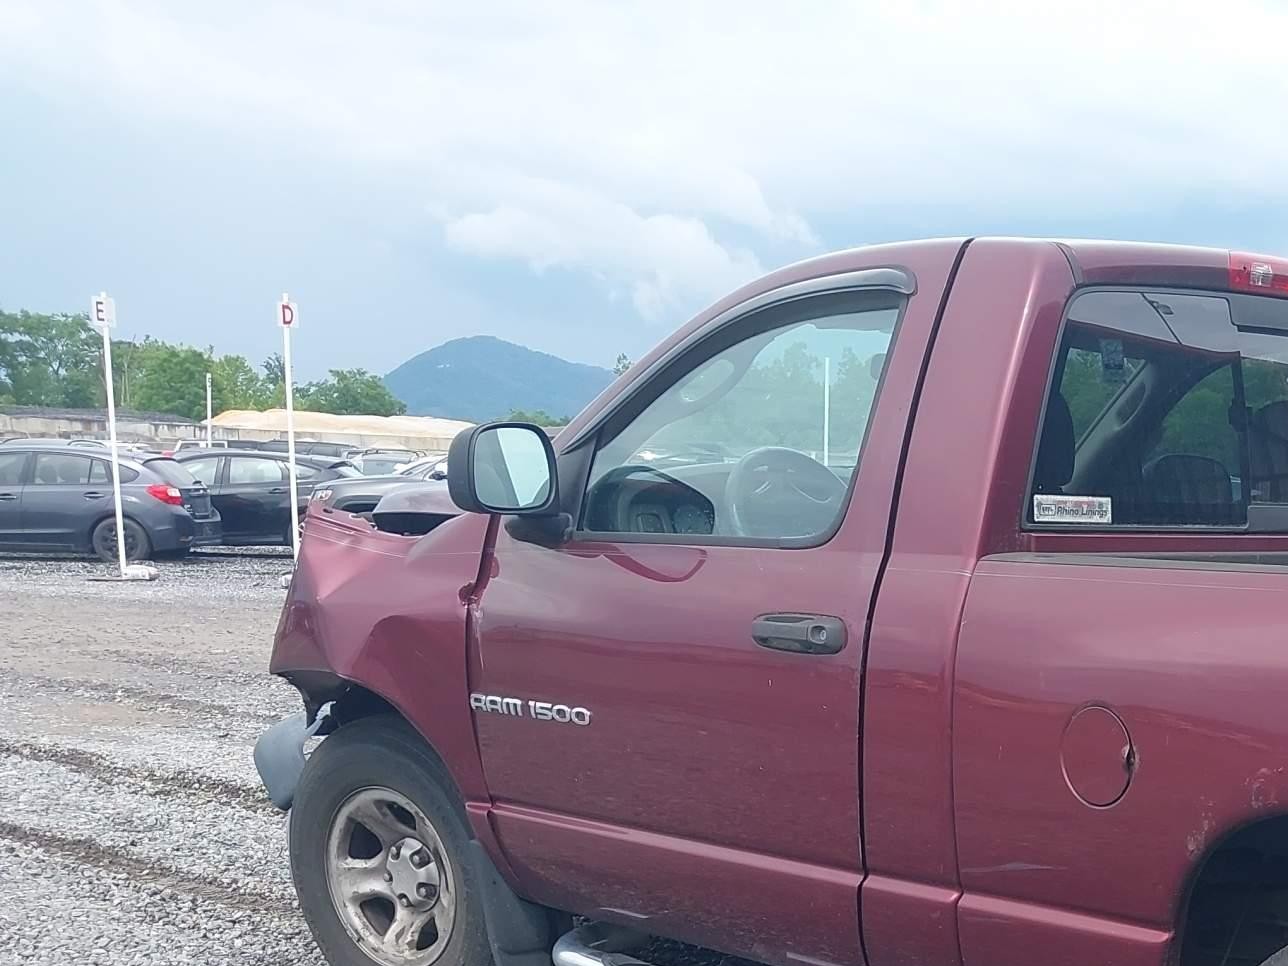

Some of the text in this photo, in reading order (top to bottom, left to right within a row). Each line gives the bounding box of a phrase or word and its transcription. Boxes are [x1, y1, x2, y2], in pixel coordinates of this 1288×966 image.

[95, 301, 105, 322] E
[281, 303, 294, 325] D
[1056, 506, 1079, 516] Rhino
[1081, 507, 1108, 518] Linings
[470, 693, 592, 725] RAM 1500
